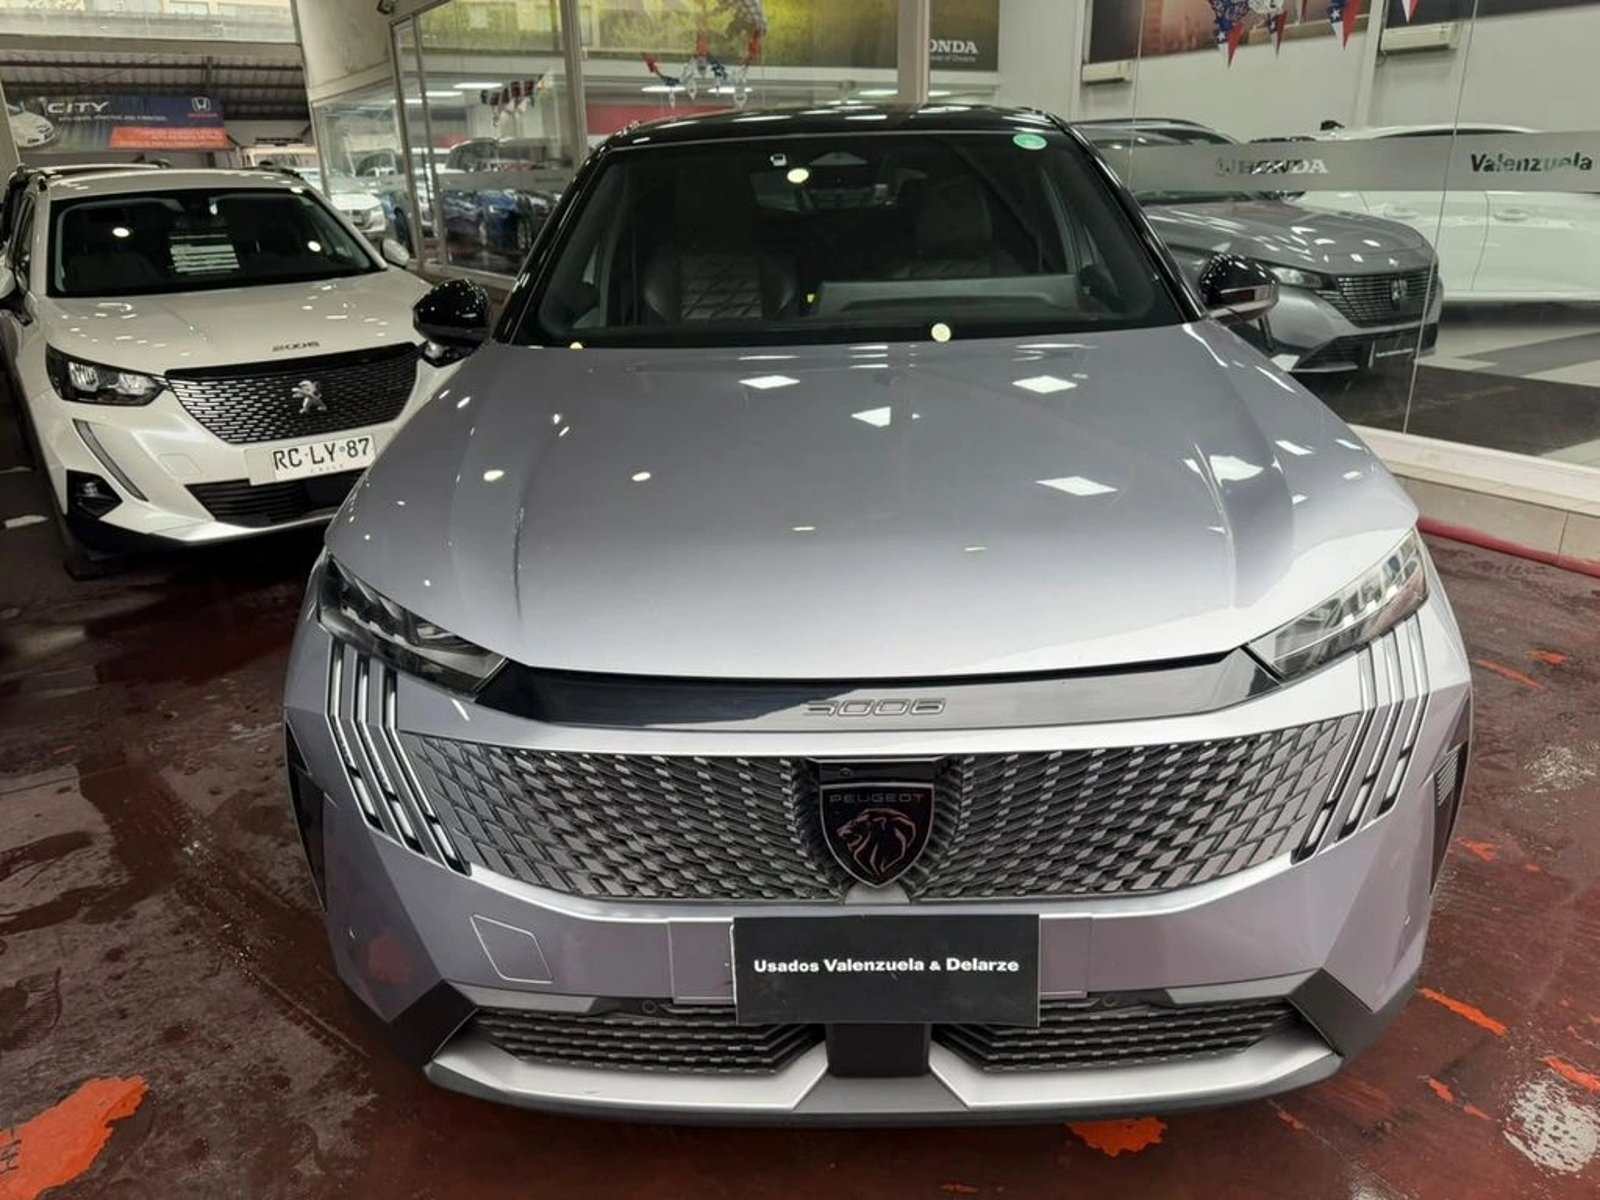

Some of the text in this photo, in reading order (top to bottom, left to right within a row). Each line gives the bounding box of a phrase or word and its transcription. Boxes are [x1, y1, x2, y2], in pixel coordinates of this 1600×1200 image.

[929, 39, 979, 54] ONDA
[48, 102, 109, 113] CITY
[1239, 159, 1328, 174] HONDA
[1471, 152, 1593, 172] Valenzuela
[829, 793, 925, 803] PEUGEOT
[753, 958, 1020, 973] Usados Valenzuela & Delarze
